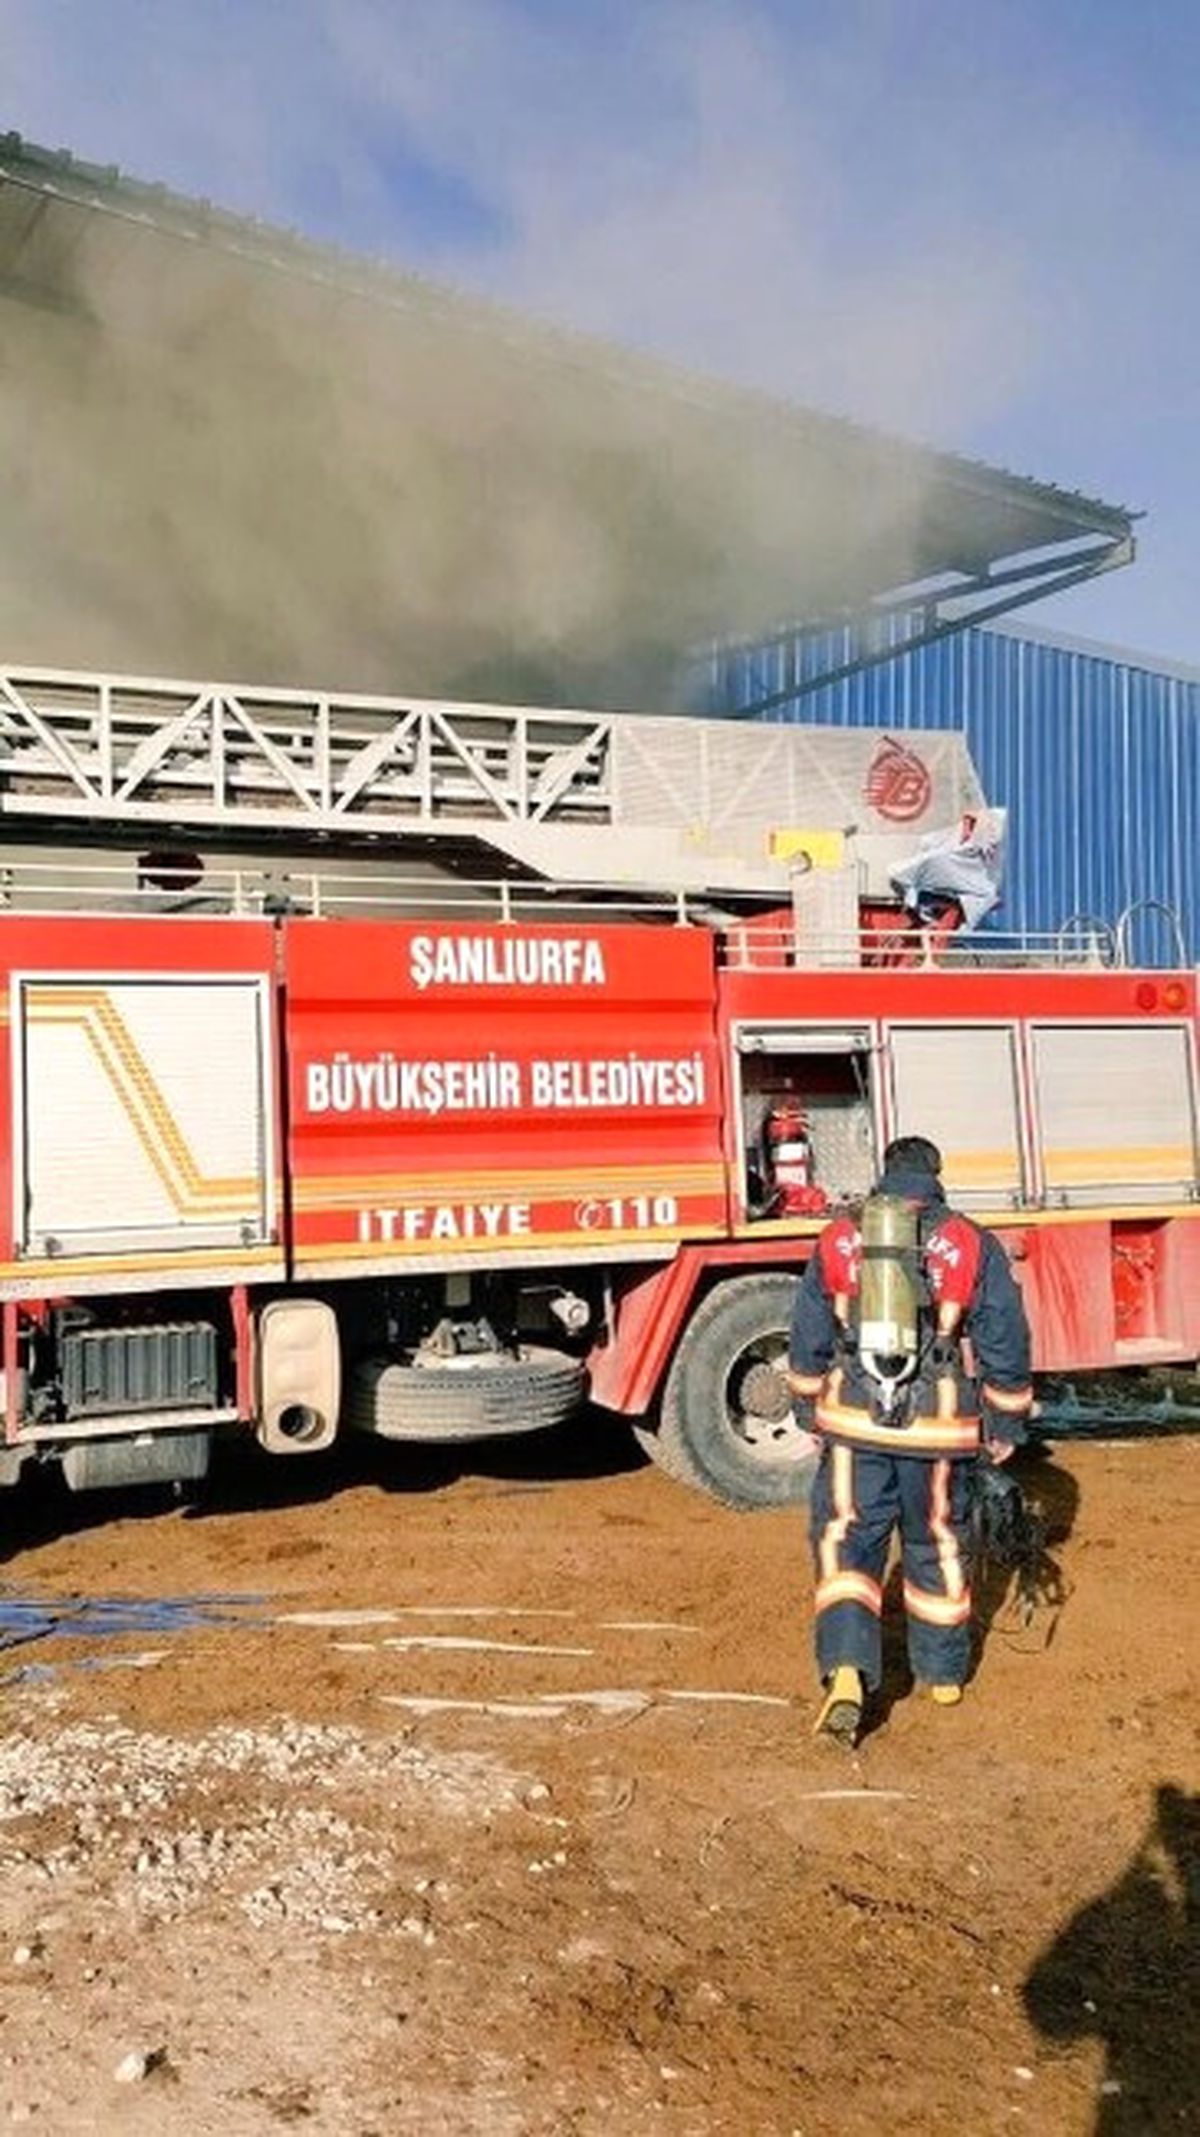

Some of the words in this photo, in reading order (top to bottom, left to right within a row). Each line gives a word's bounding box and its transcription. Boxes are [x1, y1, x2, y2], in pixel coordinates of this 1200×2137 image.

[410, 936, 606, 990] ŞANLIURFA
[307, 1052, 521, 1115] BÜYÜKŞEHİR
[531, 1052, 705, 1107] BELEDİYESİ
[606, 1195, 678, 1227] 110
